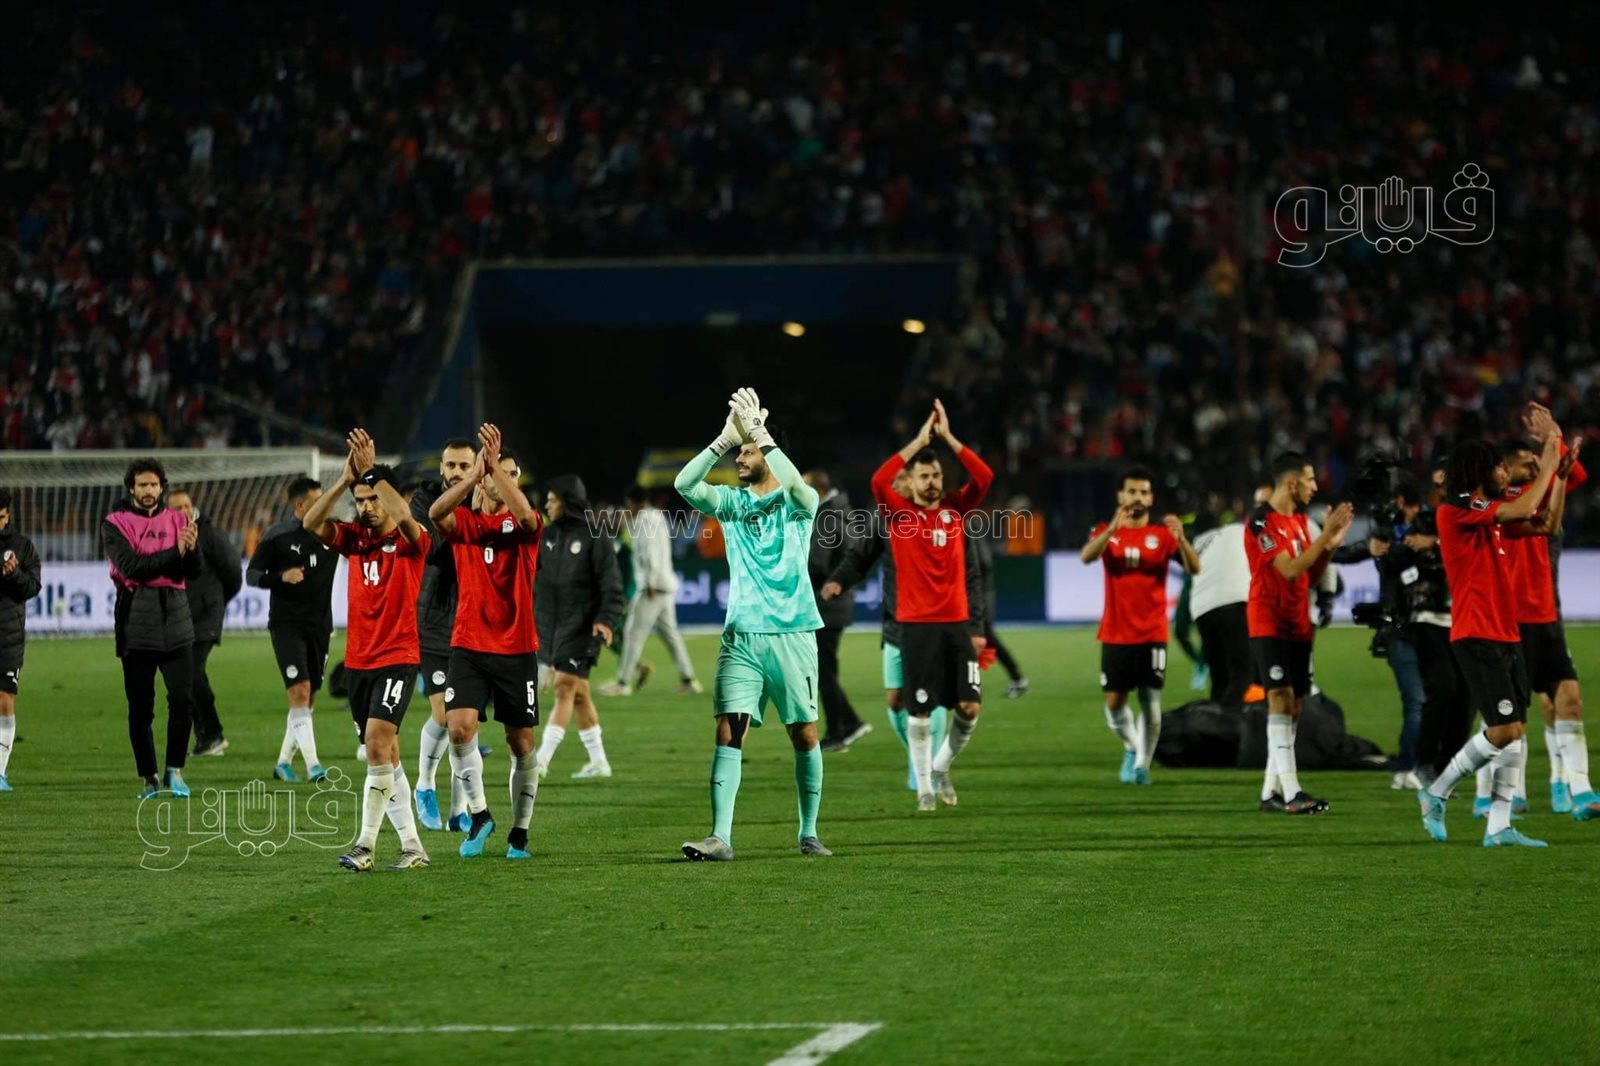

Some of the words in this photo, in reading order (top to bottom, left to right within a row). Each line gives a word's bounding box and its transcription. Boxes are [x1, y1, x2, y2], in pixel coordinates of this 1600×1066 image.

[1150, 647, 1167, 671] 10
[382, 678, 405, 704] 14
[526, 680, 535, 705] 5
[805, 676, 813, 700] 1
